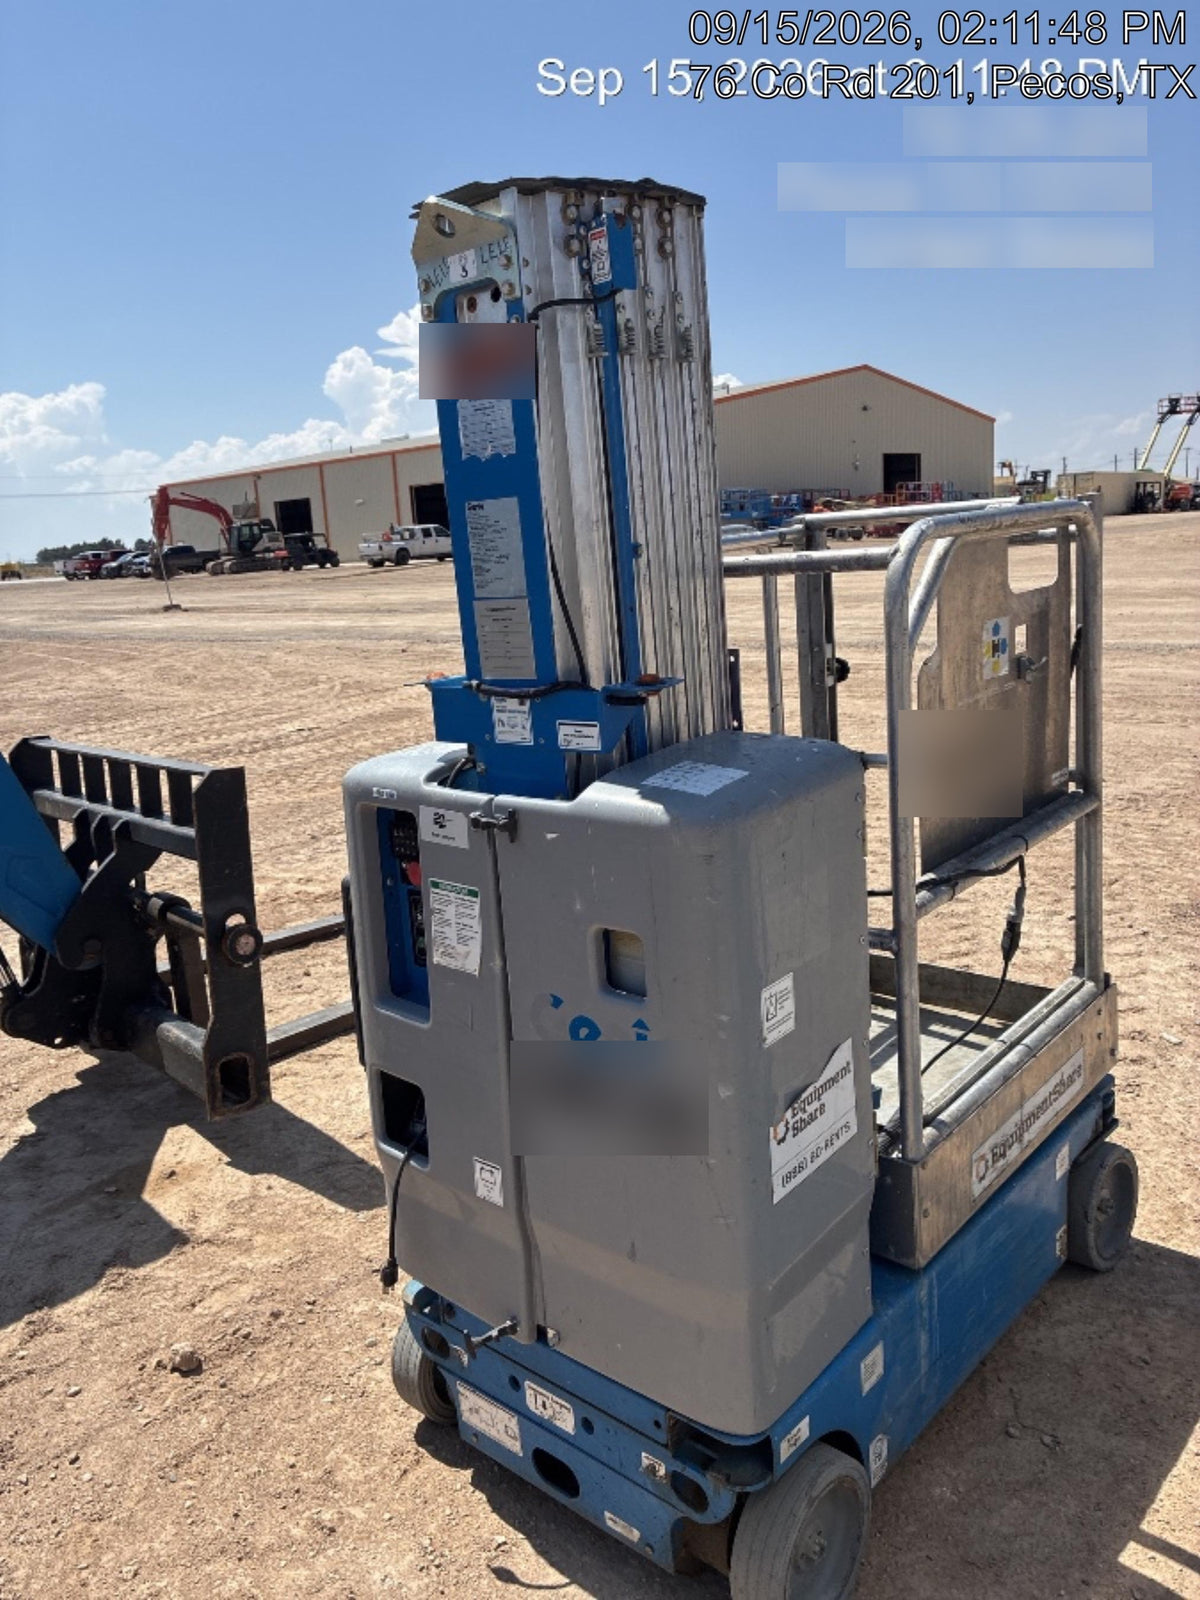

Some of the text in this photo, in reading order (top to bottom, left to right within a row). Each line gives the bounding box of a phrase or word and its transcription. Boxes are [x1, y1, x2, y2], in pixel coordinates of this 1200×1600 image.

[790, 1060, 852, 1119] Equipment
[991, 1064, 1083, 1167] EquipmentShare
[792, 1102, 826, 1139] Share
